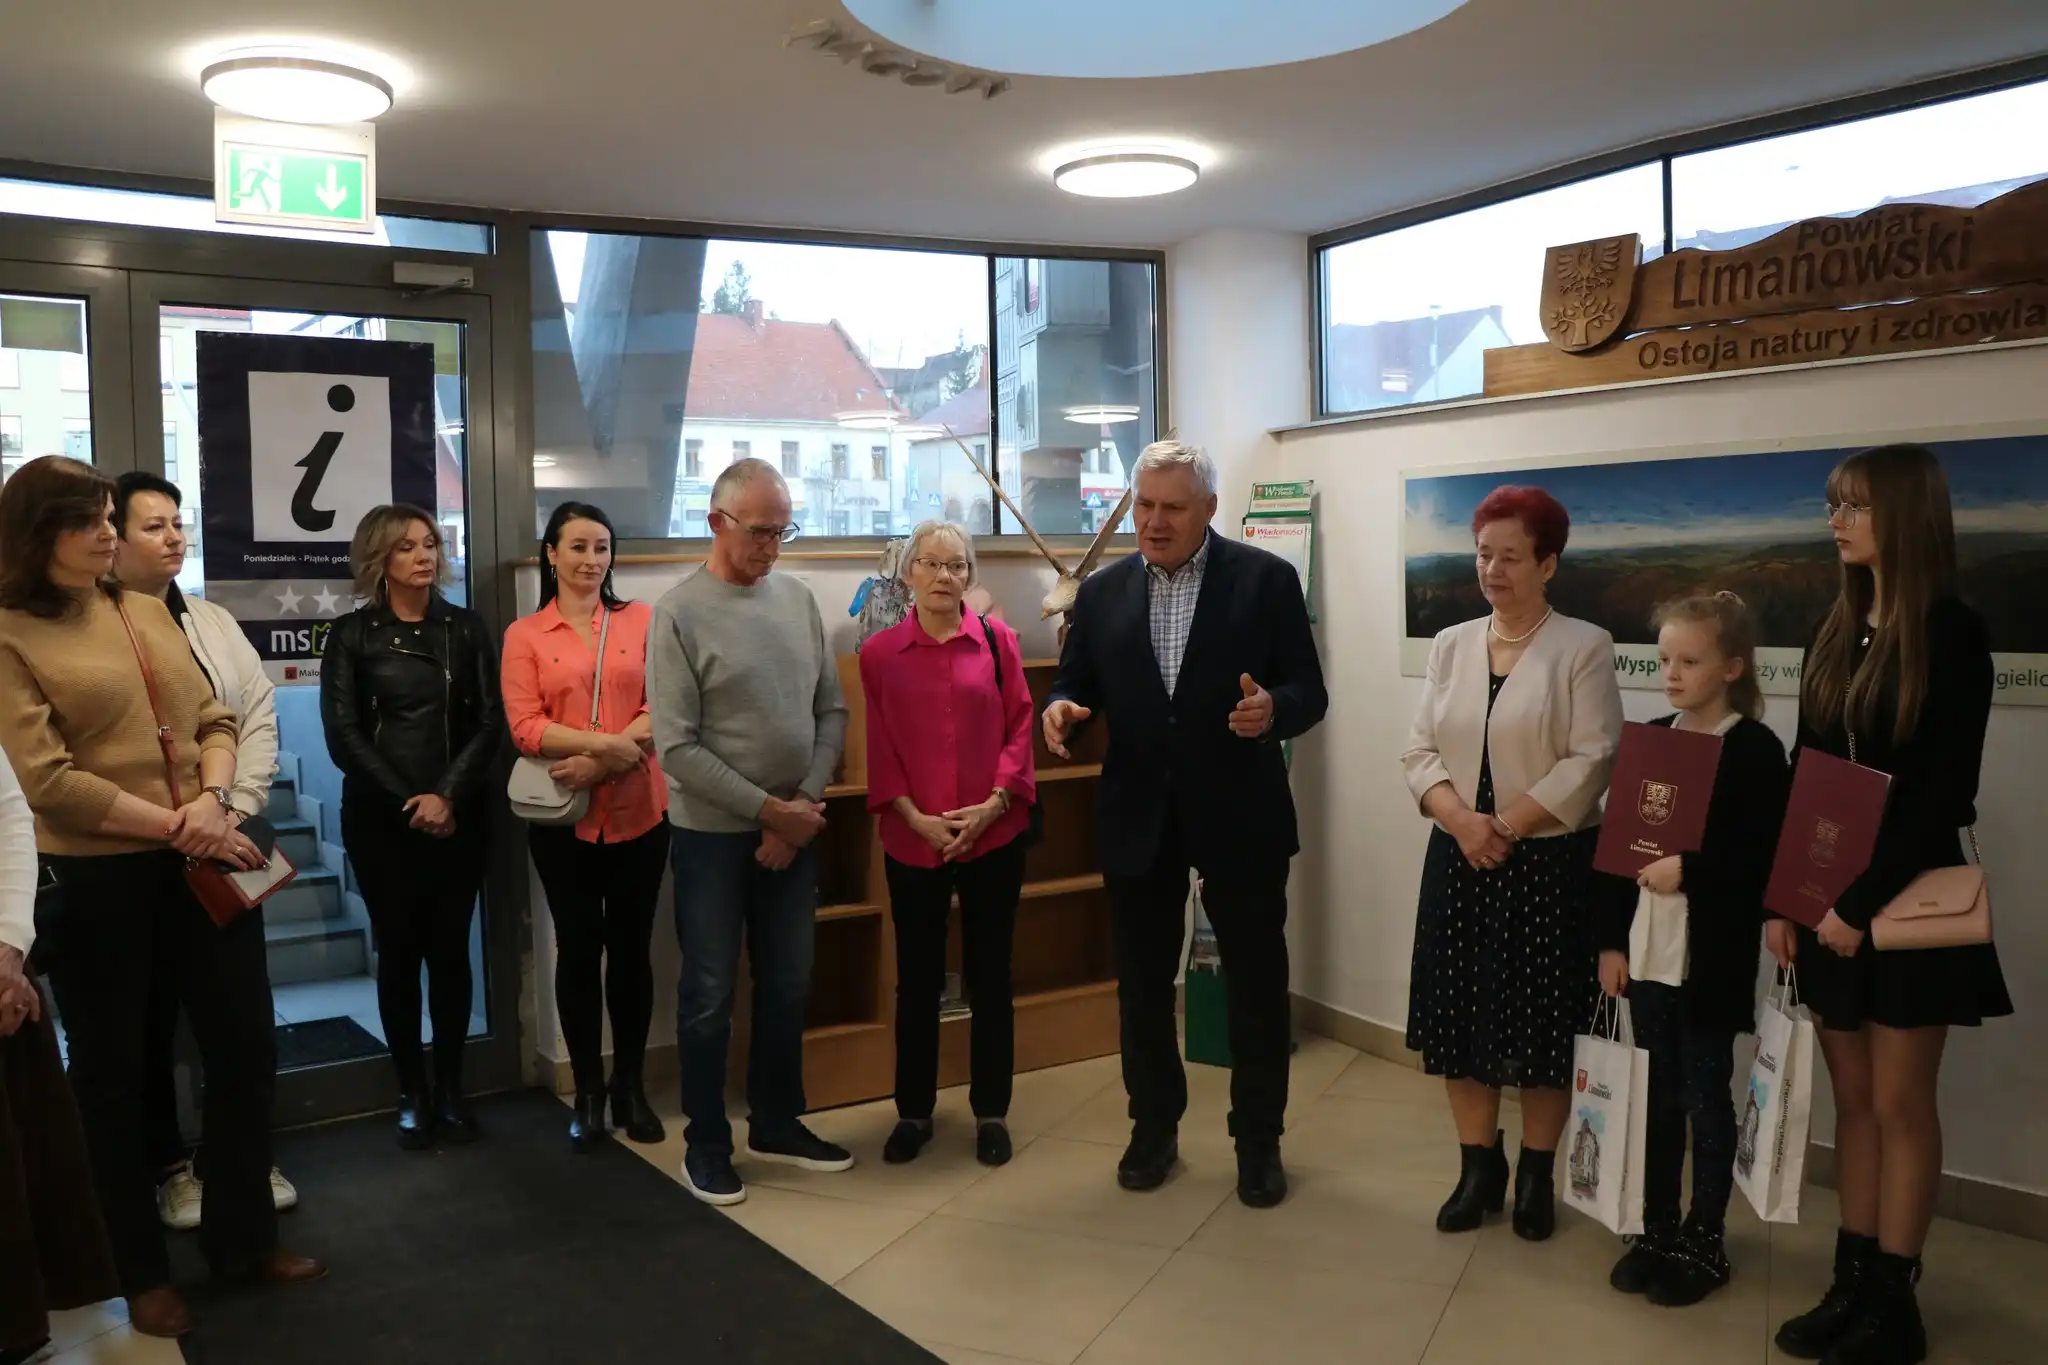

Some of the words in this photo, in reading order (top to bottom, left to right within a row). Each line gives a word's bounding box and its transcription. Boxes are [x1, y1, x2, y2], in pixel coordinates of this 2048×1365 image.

[1796, 207, 1926, 250] Powiat
[1673, 217, 1975, 309] Limanowski
[1638, 335, 1739, 370] Ostoja
[1750, 323, 1861, 356] natury
[1870, 315, 1880, 345] i
[1888, 298, 2048, 343] zdrowia
[243, 554, 297, 563] Poniedziałek
[303, 554, 330, 564] Piątek
[1613, 655, 1661, 677] Wysp
[1630, 843, 1664, 856] Limanowski
[1637, 838, 1658, 848] Powiat
